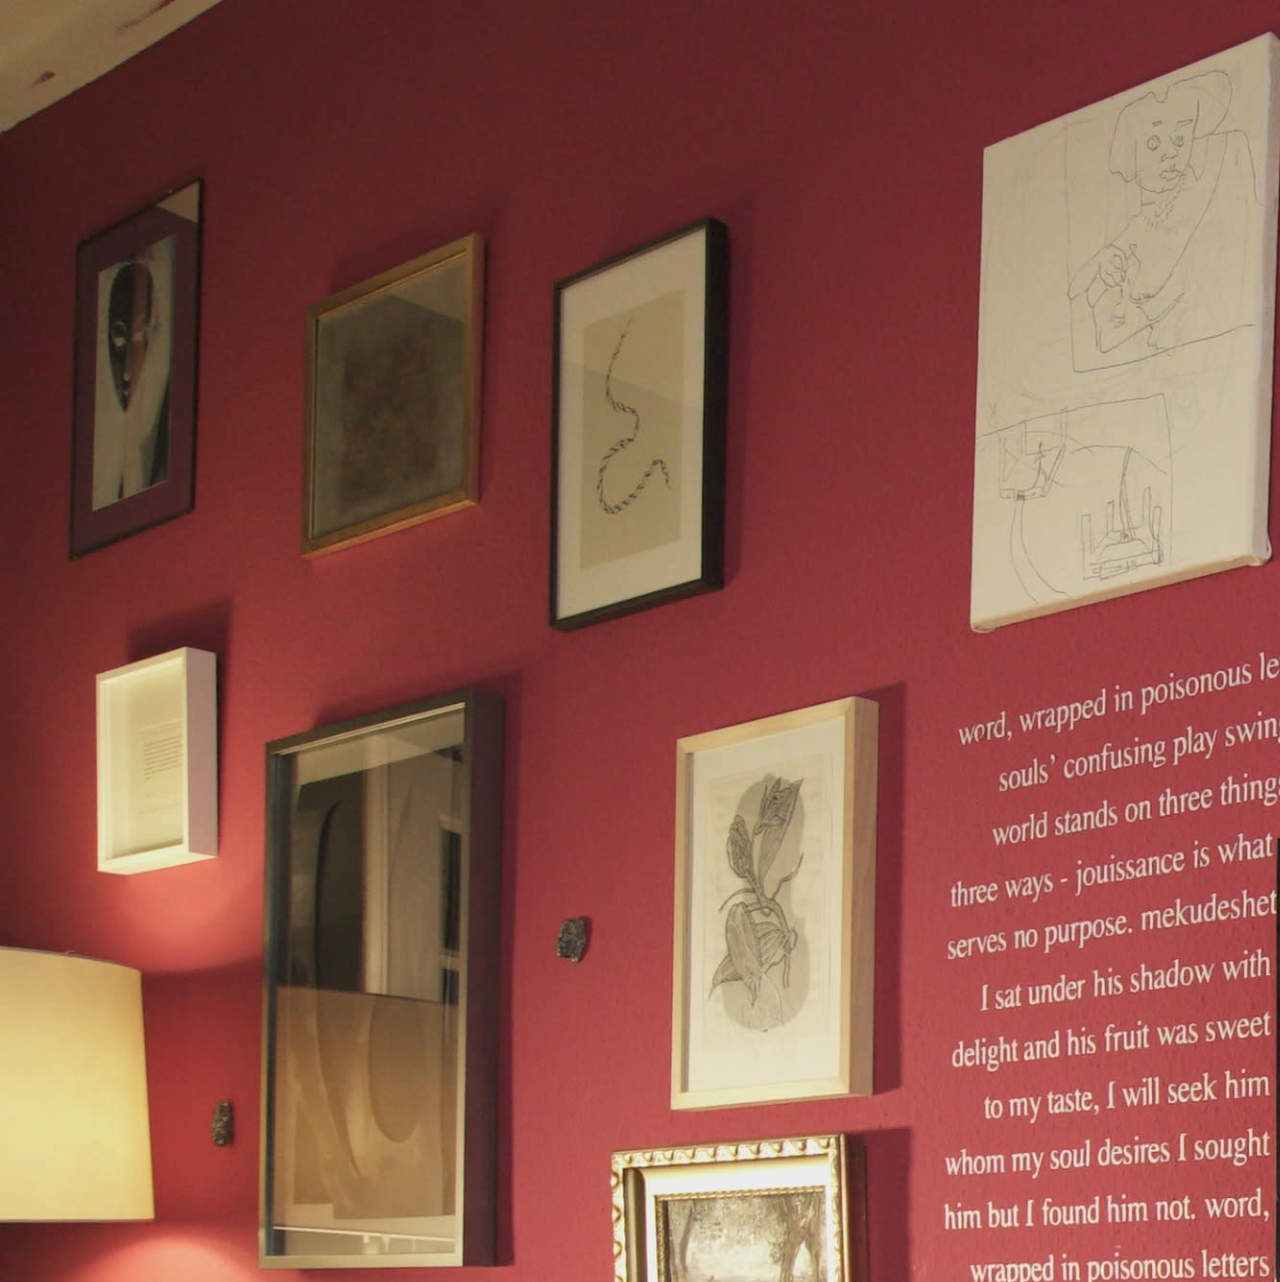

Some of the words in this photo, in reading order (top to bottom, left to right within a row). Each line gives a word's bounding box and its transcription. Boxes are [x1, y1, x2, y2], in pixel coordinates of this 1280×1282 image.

[959, 711, 1012, 745] word,
[1019, 688, 1106, 733] wrapped
[1114, 685, 1133, 712] in
[1141, 664, 1252, 715] poisonous
[999, 754, 1055, 791] souls'
[1064, 737, 1166, 778] confusing
[1173, 726, 1217, 765] play
[992, 811, 1047, 845] world
[1055, 800, 1118, 835] stands
[1125, 800, 1152, 822] on
[1158, 788, 1213, 816] three
[948, 932, 1006, 959] serves
[1014, 929, 1038, 949] no
[1044, 916, 1132, 953] purpose.
[1141, 890, 1276, 930] mekudeshet
[952, 1036, 1018, 1072] delight
[1024, 1030, 1059, 1061] and
[1067, 1027, 1096, 1056] his
[1104, 1021, 1149, 1052] fruit
[1157, 1023, 1198, 1045] was
[1206, 1012, 1270, 1042] sweet
[945, 1149, 1005, 1175] whom
[1011, 1152, 1044, 1179] my
[1050, 1139, 1090, 1169] soul
[1097, 1136, 1170, 1166] desires
[1178, 1133, 1187, 1161] I
[1194, 1128, 1270, 1166] sought
[944, 1202, 982, 1229] him
[987, 1201, 1019, 1228] but
[1025, 1200, 1034, 1226] I
[1041, 1196, 1099, 1226] found
[1107, 1194, 1148, 1223] him
[1155, 1195, 1195, 1220] not.
[1204, 1188, 1269, 1221] word,
[1061, 1253, 1080, 1281] in
[1201, 1249, 1269, 1278] letters
